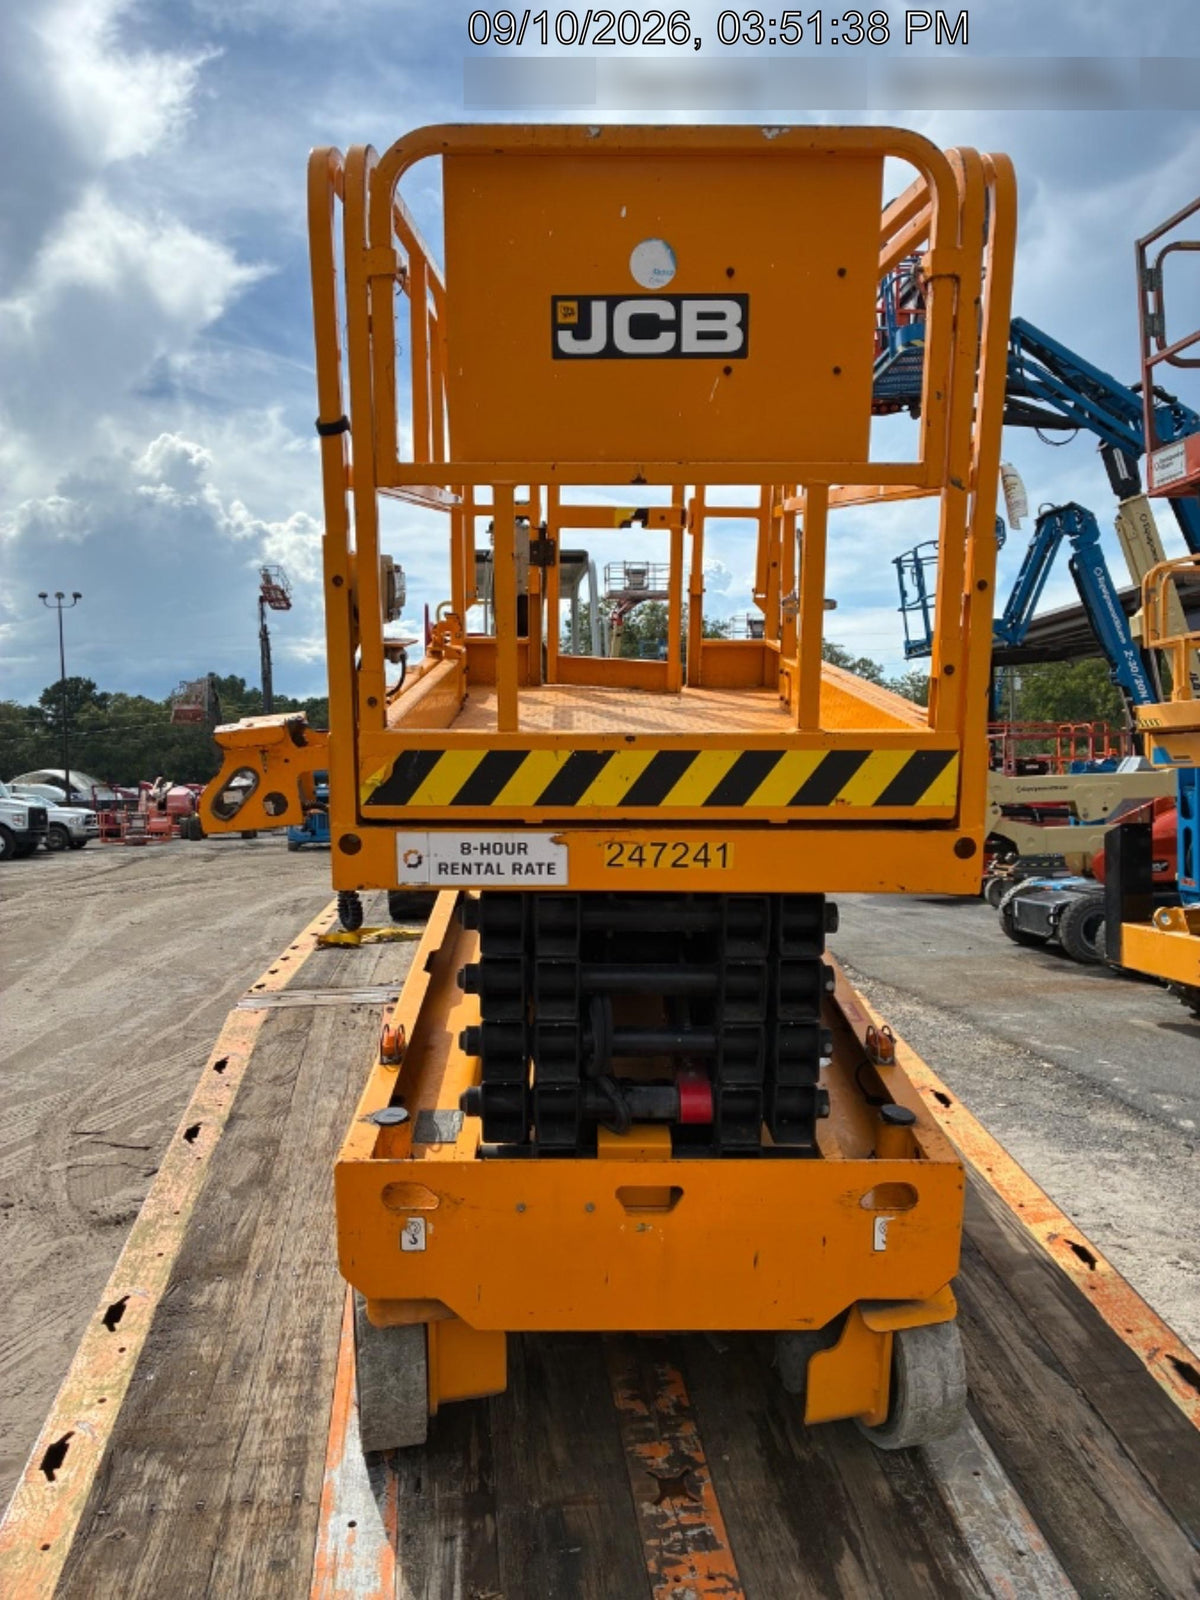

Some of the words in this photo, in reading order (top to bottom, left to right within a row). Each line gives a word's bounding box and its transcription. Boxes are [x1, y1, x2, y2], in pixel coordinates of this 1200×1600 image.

[557, 299, 744, 354] JCB
[459, 841, 529, 857] 8-HOUR
[606, 842, 729, 868] 247241
[437, 861, 506, 876] RENTAL
[511, 861, 557, 876] RATE
